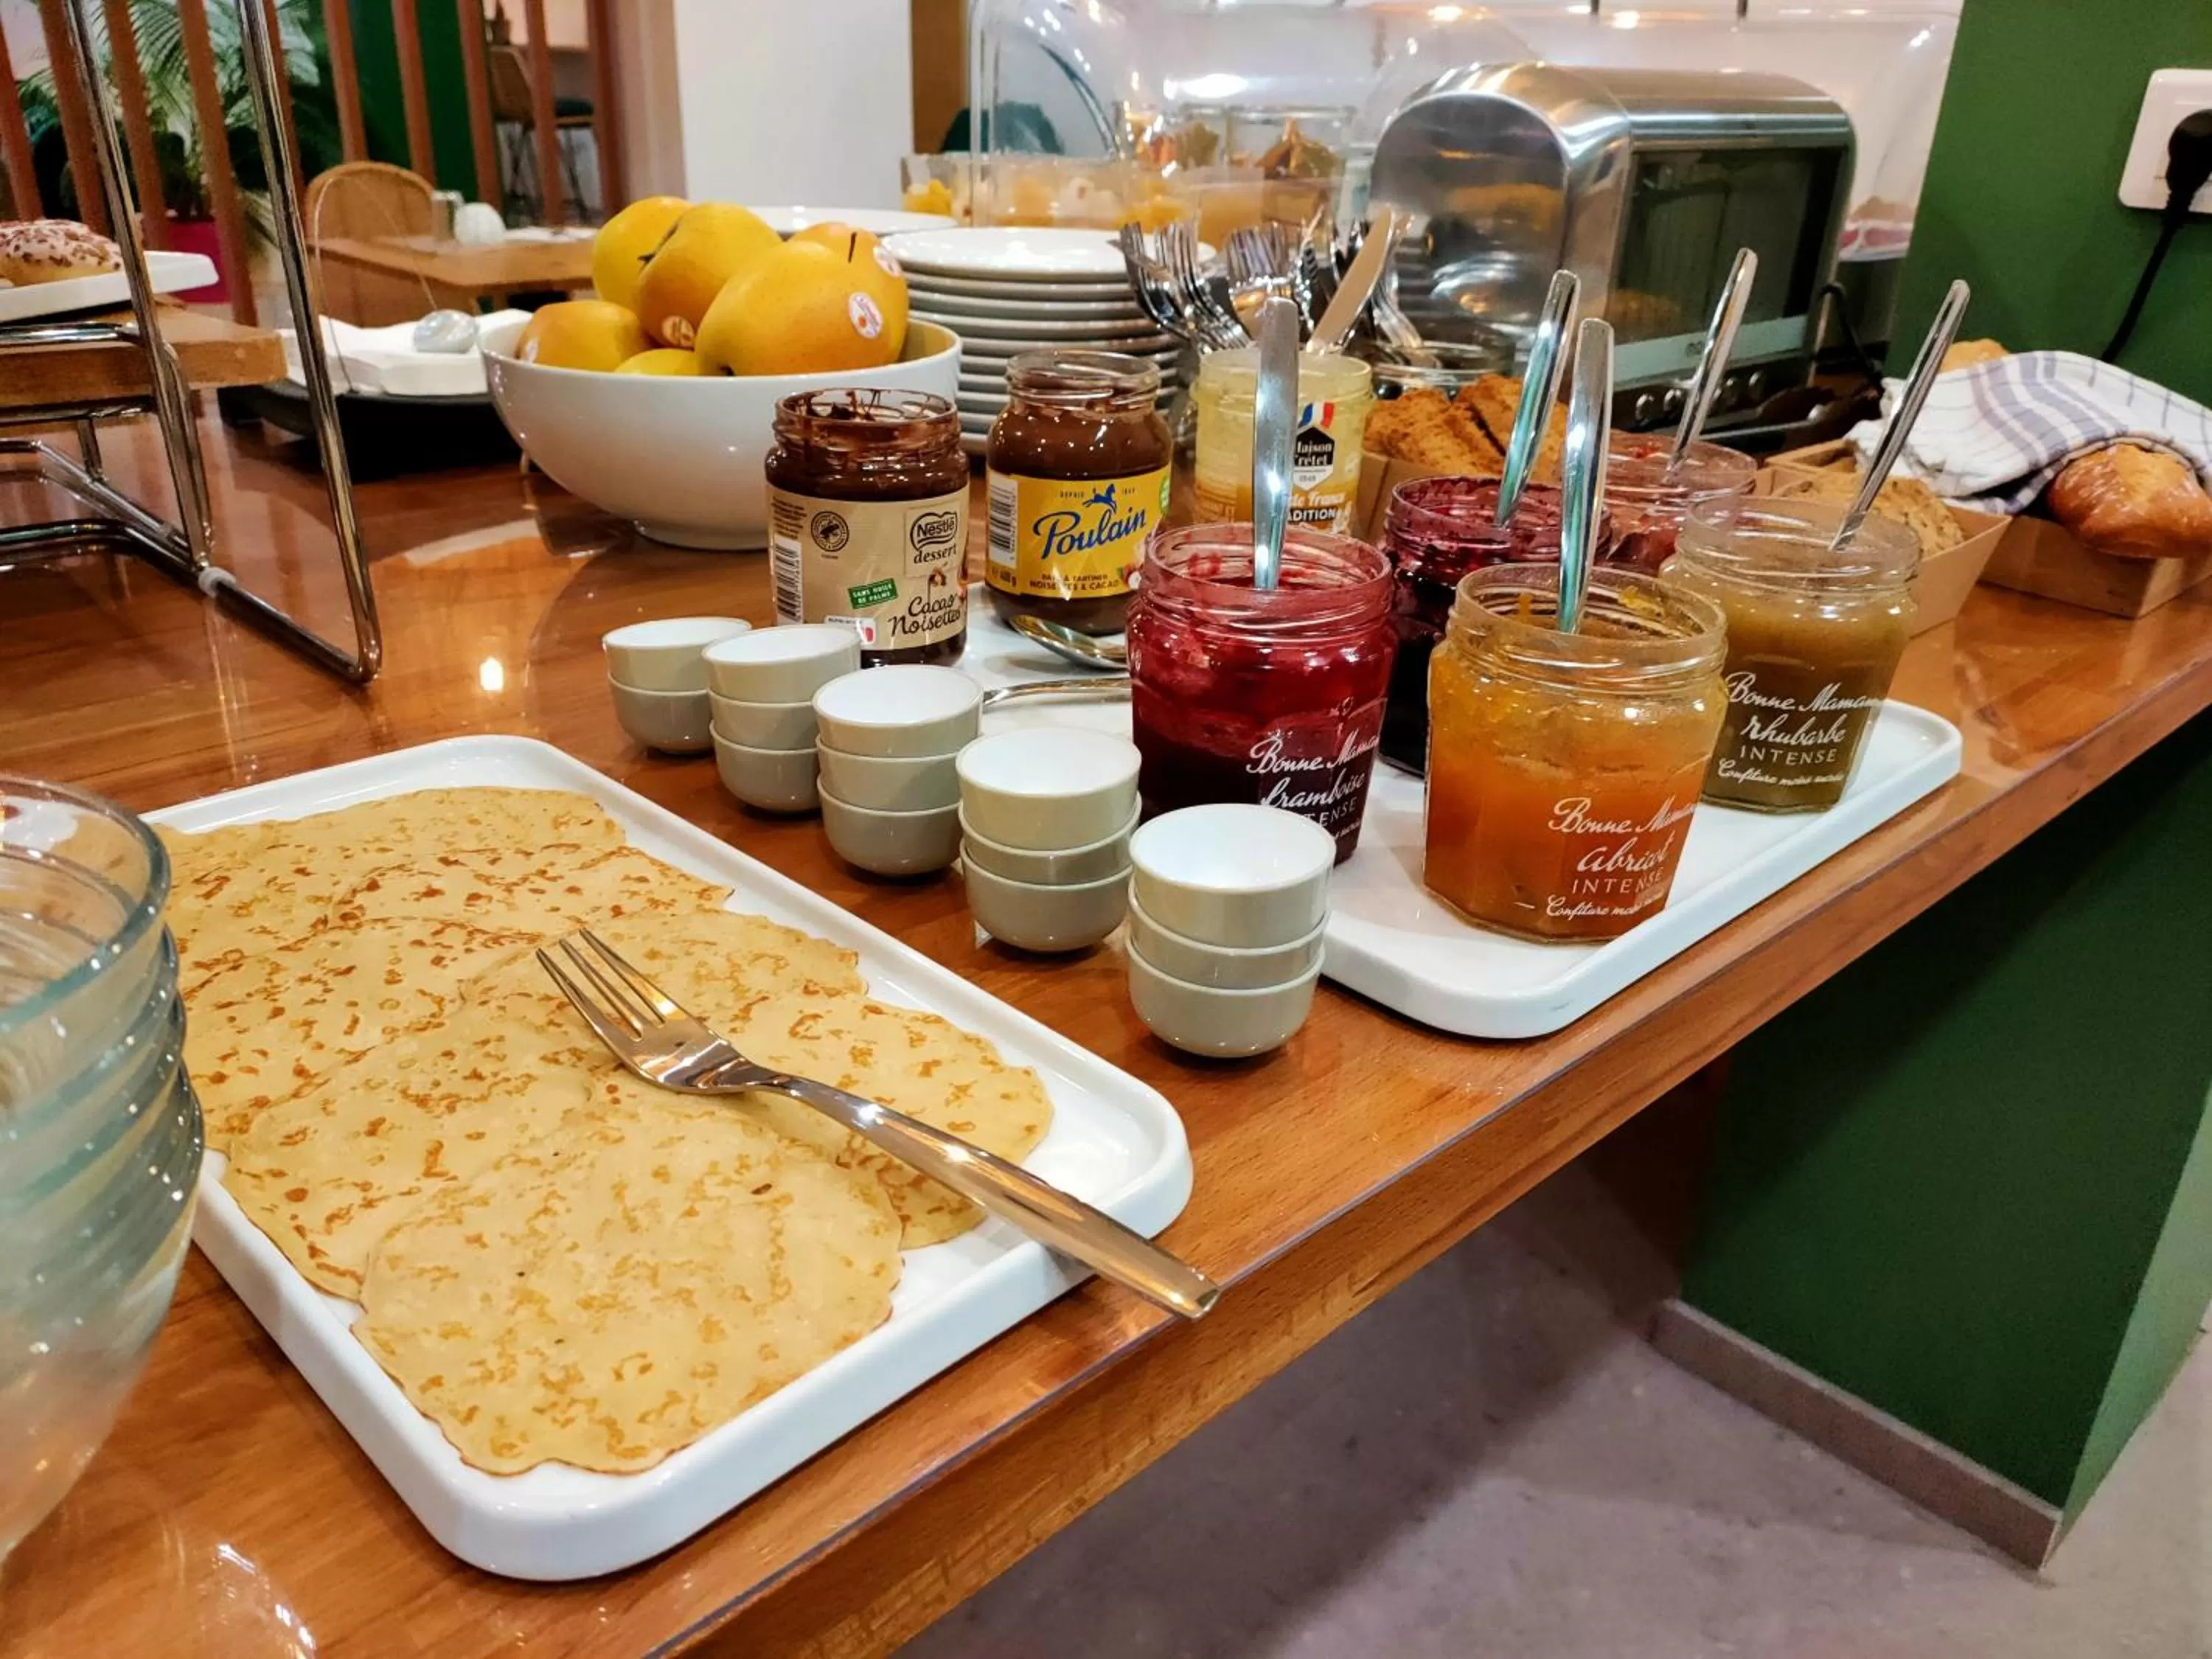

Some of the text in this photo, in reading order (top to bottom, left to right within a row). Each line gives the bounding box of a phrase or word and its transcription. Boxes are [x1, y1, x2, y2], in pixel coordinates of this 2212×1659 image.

[917, 517, 955, 538] Nestlé
[1033, 506, 1146, 560] Poulain
[914, 543, 956, 564] dessert
[1090, 580, 1119, 590] CACAO
[908, 594, 956, 617] Cacao
[1725, 672, 1878, 712] Bonne Maman
[1740, 713, 1846, 746] rhubarbe
[1246, 737, 1324, 773] Bonne
[1740, 745, 1837, 766] INTENSE
[1718, 758, 1778, 784] Confiture
[1304, 796, 1357, 827] ENSE
[1548, 797, 1632, 835] Bonne
[1572, 867, 1664, 894] INTENSE
[1546, 894, 1610, 920] Confiture
